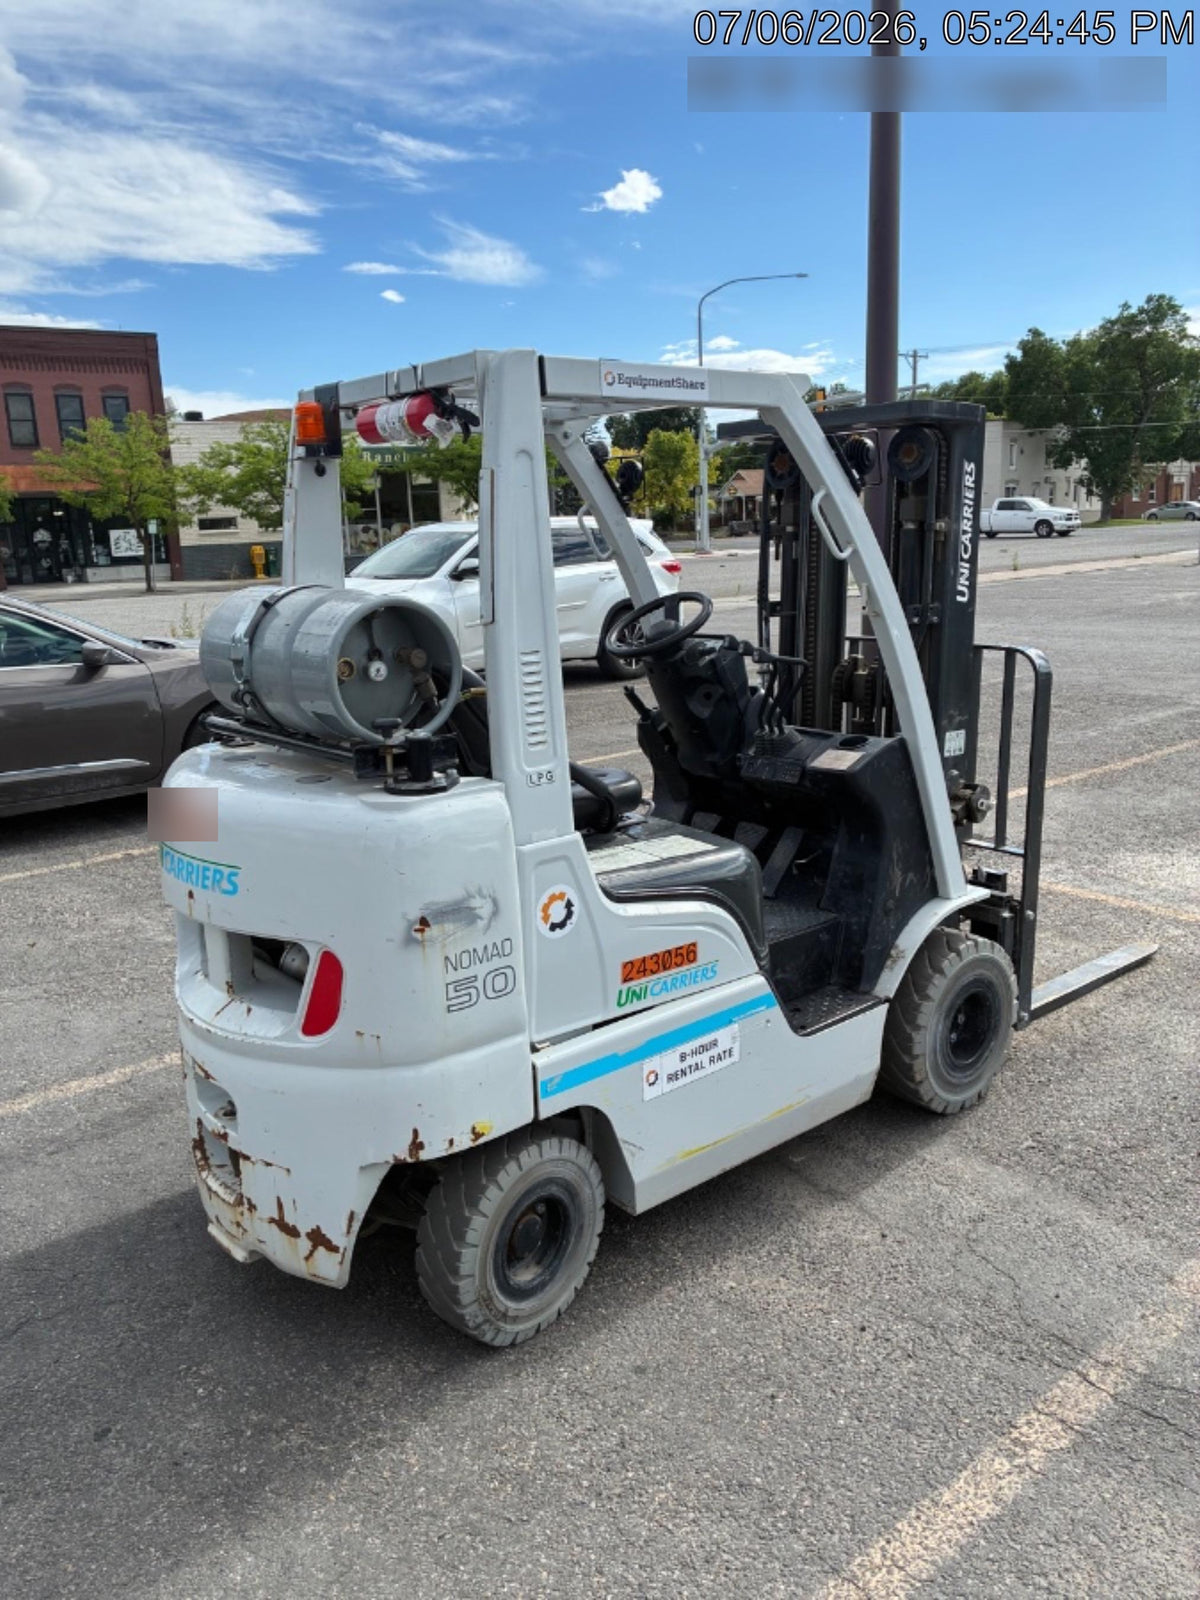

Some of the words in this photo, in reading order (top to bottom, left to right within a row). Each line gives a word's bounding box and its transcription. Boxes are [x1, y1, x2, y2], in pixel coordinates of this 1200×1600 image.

[617, 373, 706, 389] EquipmentShare
[529, 771, 554, 785] LPG
[444, 938, 513, 974] NOMAD
[622, 942, 698, 983] 243056
[445, 965, 516, 1013] 50
[666, 1060, 706, 1084] RENTAL
[709, 1046, 734, 1066] RATE
